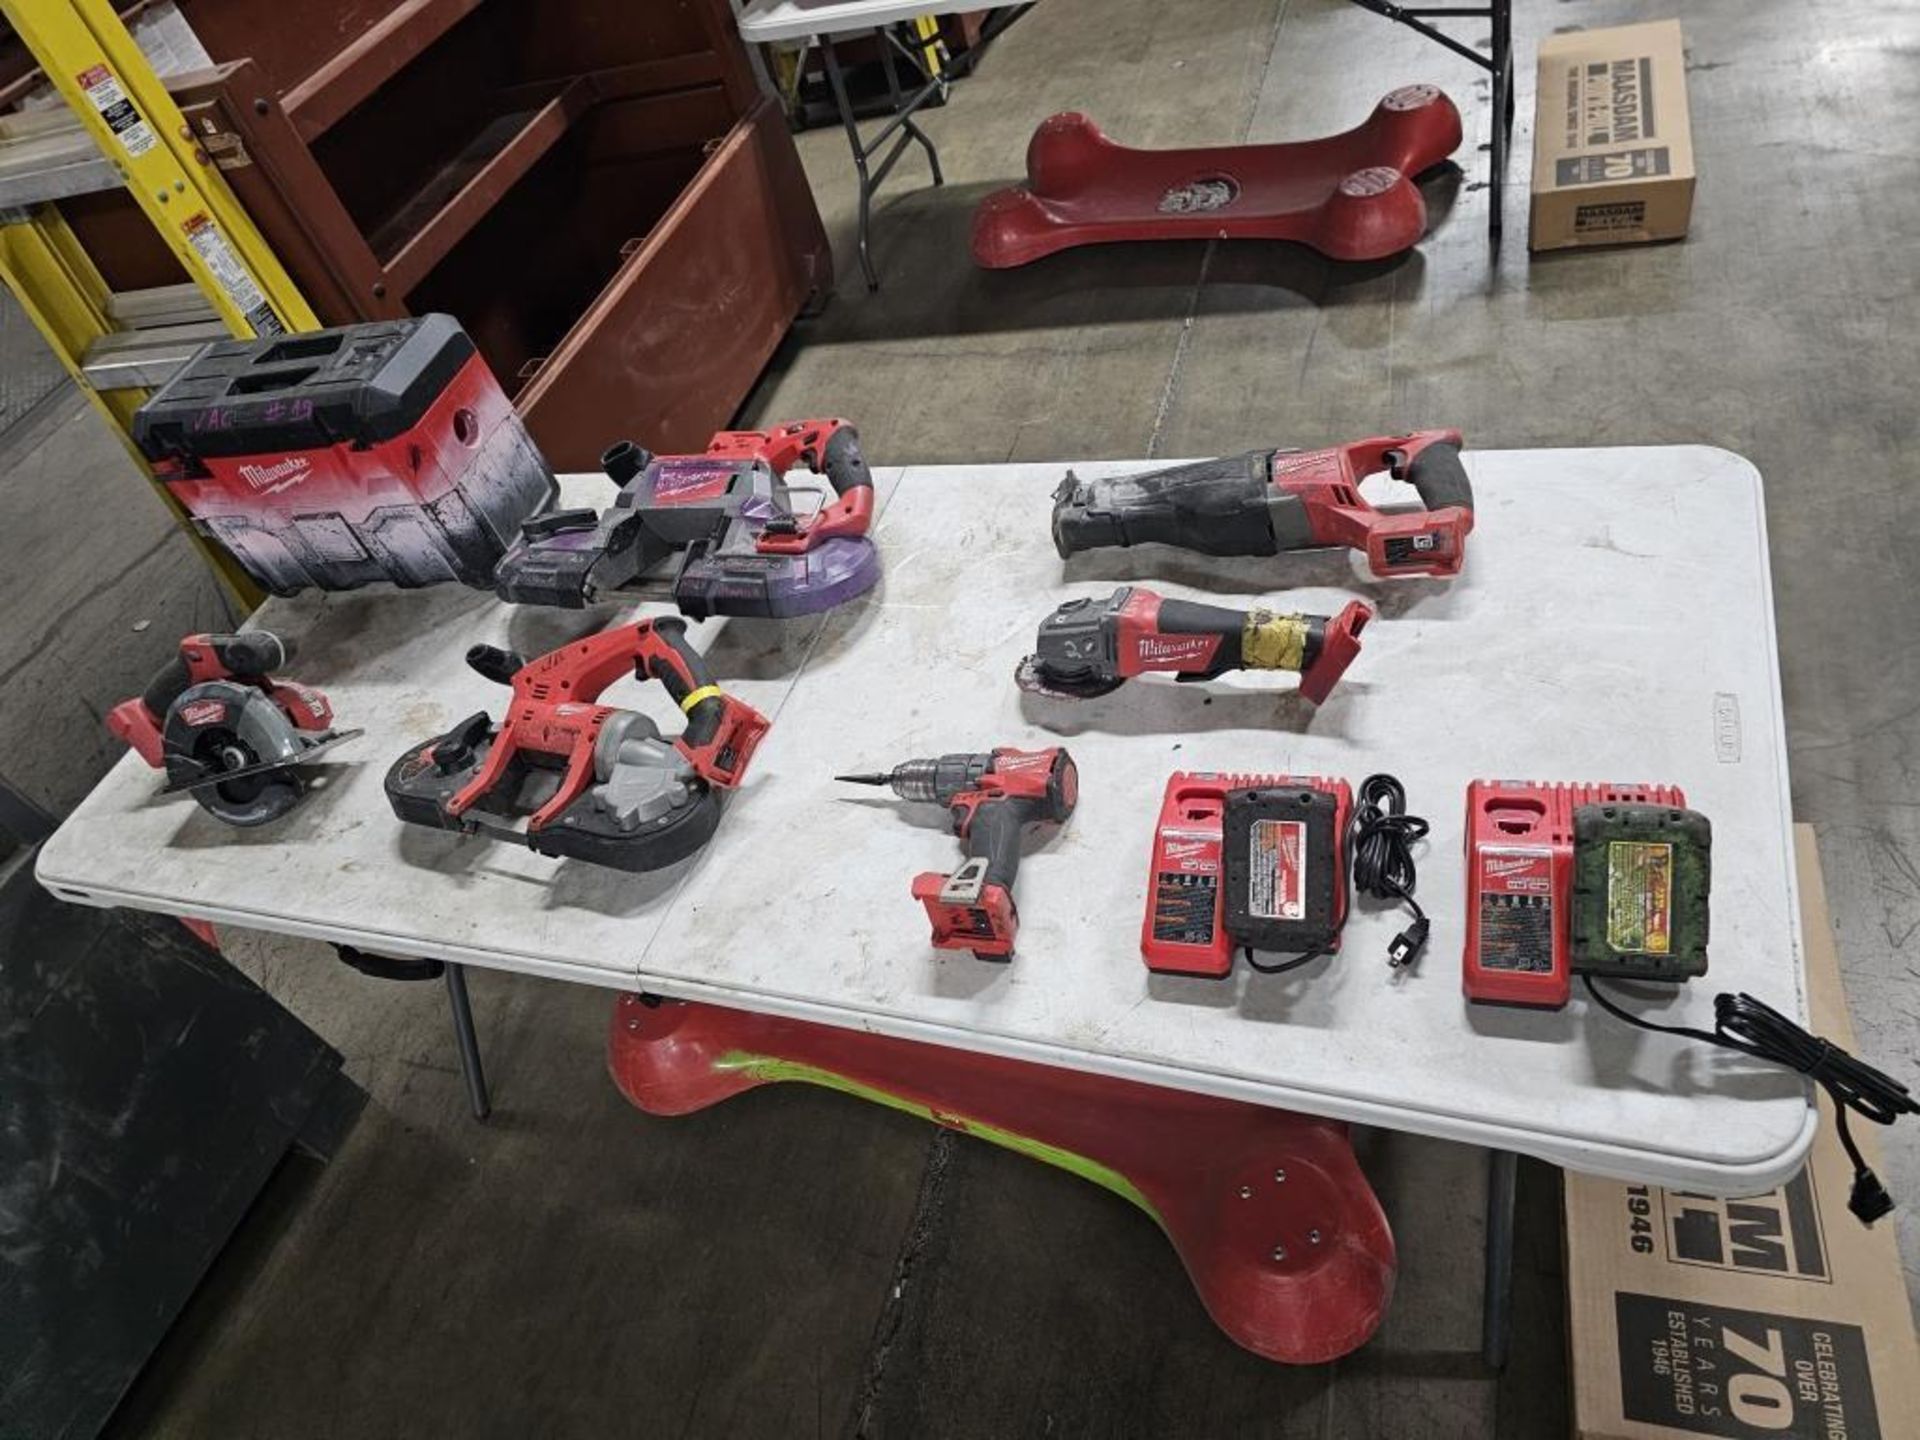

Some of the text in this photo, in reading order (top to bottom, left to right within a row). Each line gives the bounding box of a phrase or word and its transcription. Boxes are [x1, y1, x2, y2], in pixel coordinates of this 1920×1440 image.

[1611, 59, 1638, 142] MAASDAM
[1604, 152, 1633, 178] 70
[238, 457, 311, 489] Milwaukee
[1626, 1184, 1655, 1254] 1946
[1651, 1338, 1671, 1377] 1946
[1667, 1309, 1696, 1416] ESTABLISHED
[1692, 1316, 1722, 1418] YEARS
[1721, 1325, 1795, 1431] 70
[1794, 1359, 1819, 1403] OVER
[1811, 1331, 1848, 1440] CELEBRATING
